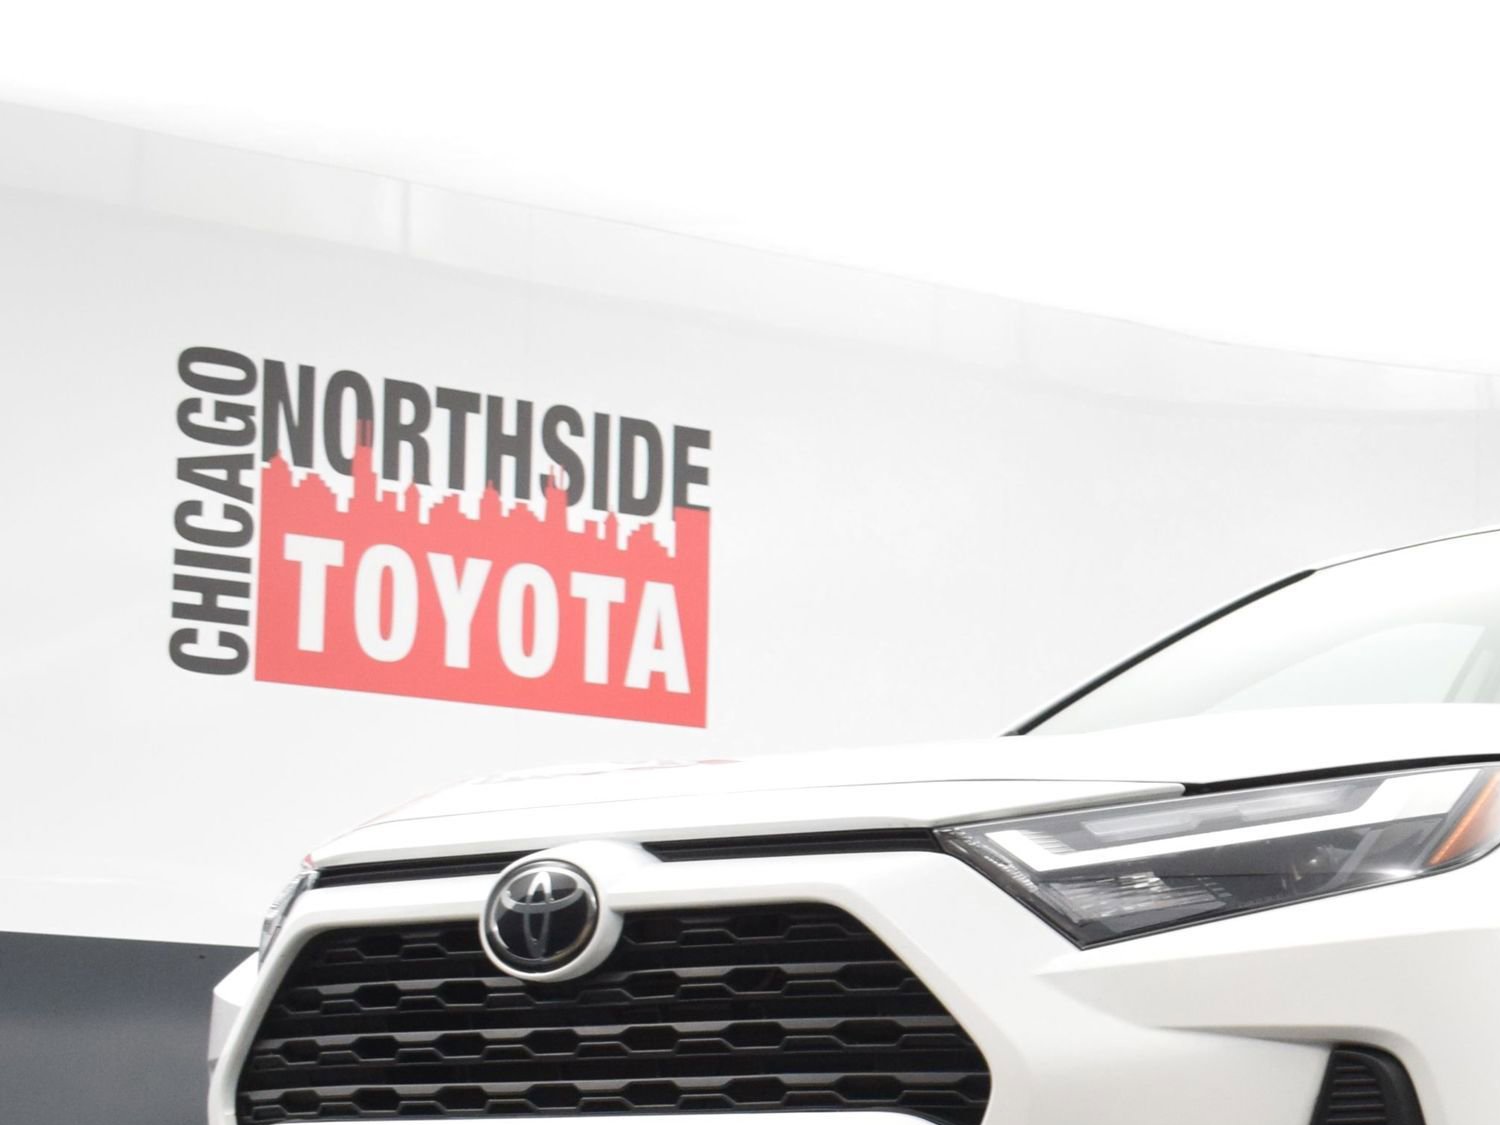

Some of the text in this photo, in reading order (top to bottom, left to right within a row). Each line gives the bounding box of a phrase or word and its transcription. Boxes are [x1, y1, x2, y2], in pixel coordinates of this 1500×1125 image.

[168, 346, 257, 676] CHICAGO
[262, 358, 711, 517] NORTHSIDE
[284, 533, 690, 694] TOYOTA
